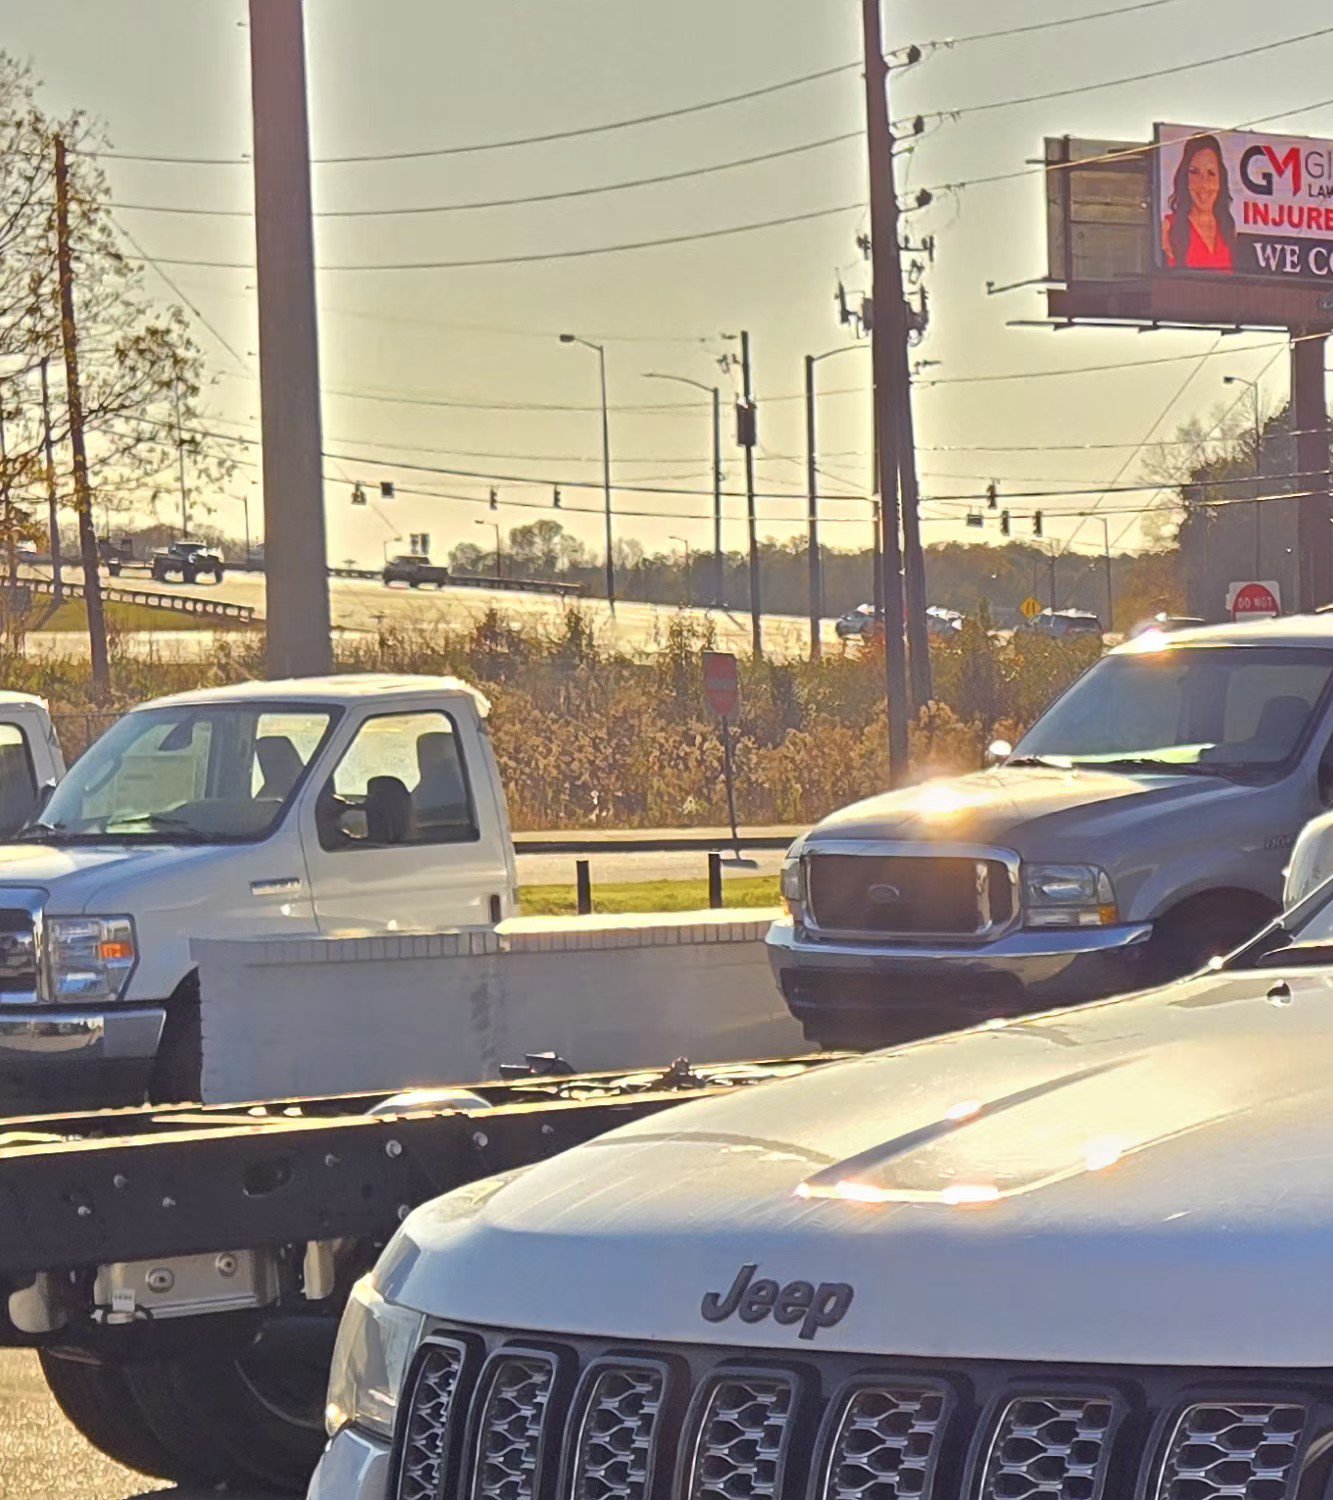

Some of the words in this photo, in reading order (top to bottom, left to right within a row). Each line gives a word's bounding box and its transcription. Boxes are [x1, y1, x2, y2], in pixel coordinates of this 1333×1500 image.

[1240, 145, 1302, 196] GM
[1252, 242, 1301, 272] WE
[1238, 597, 1251, 609] DO
[1254, 596, 1272, 608] NOT
[701, 1264, 854, 1340] Jeep
